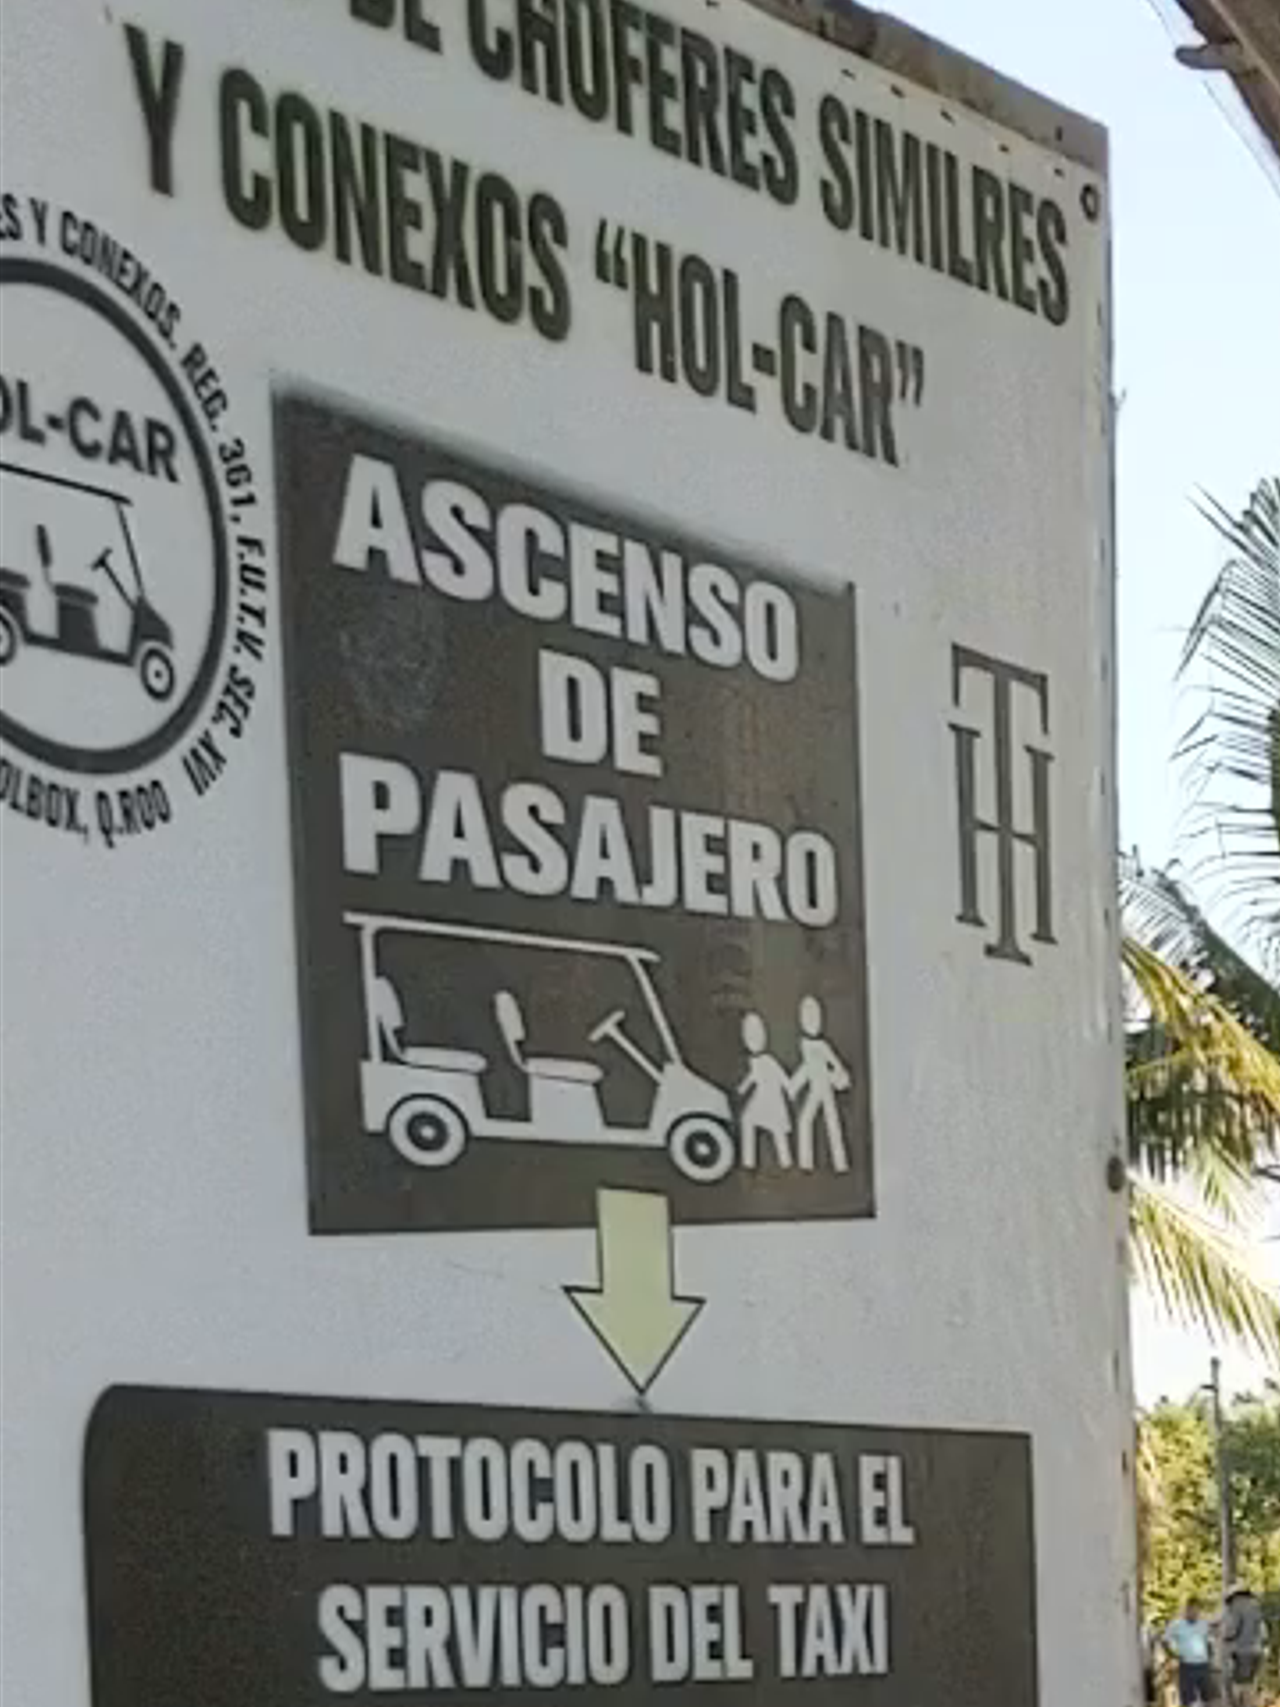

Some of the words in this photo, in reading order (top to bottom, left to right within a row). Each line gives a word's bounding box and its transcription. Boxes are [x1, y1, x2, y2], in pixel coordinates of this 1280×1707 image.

[123, 22, 184, 197] Y
[217, 67, 570, 342] CONEXOS
[818, 95, 1069, 326] SIMILRES
[29, 196, 48, 246] Y
[181, 343, 228, 433] REG.
[333, 452, 797, 682] ASCENSO
[539, 646, 662, 778] DE
[339, 752, 837, 929] PASAJERO
[267, 1428, 673, 1545] PROTOCOLO
[692, 1449, 841, 1543] PARA
[859, 1454, 913, 1545] EL
[317, 1582, 627, 1693] SERVICIO
[649, 1586, 753, 1683] DEL
[769, 1584, 888, 1677] TAXI
